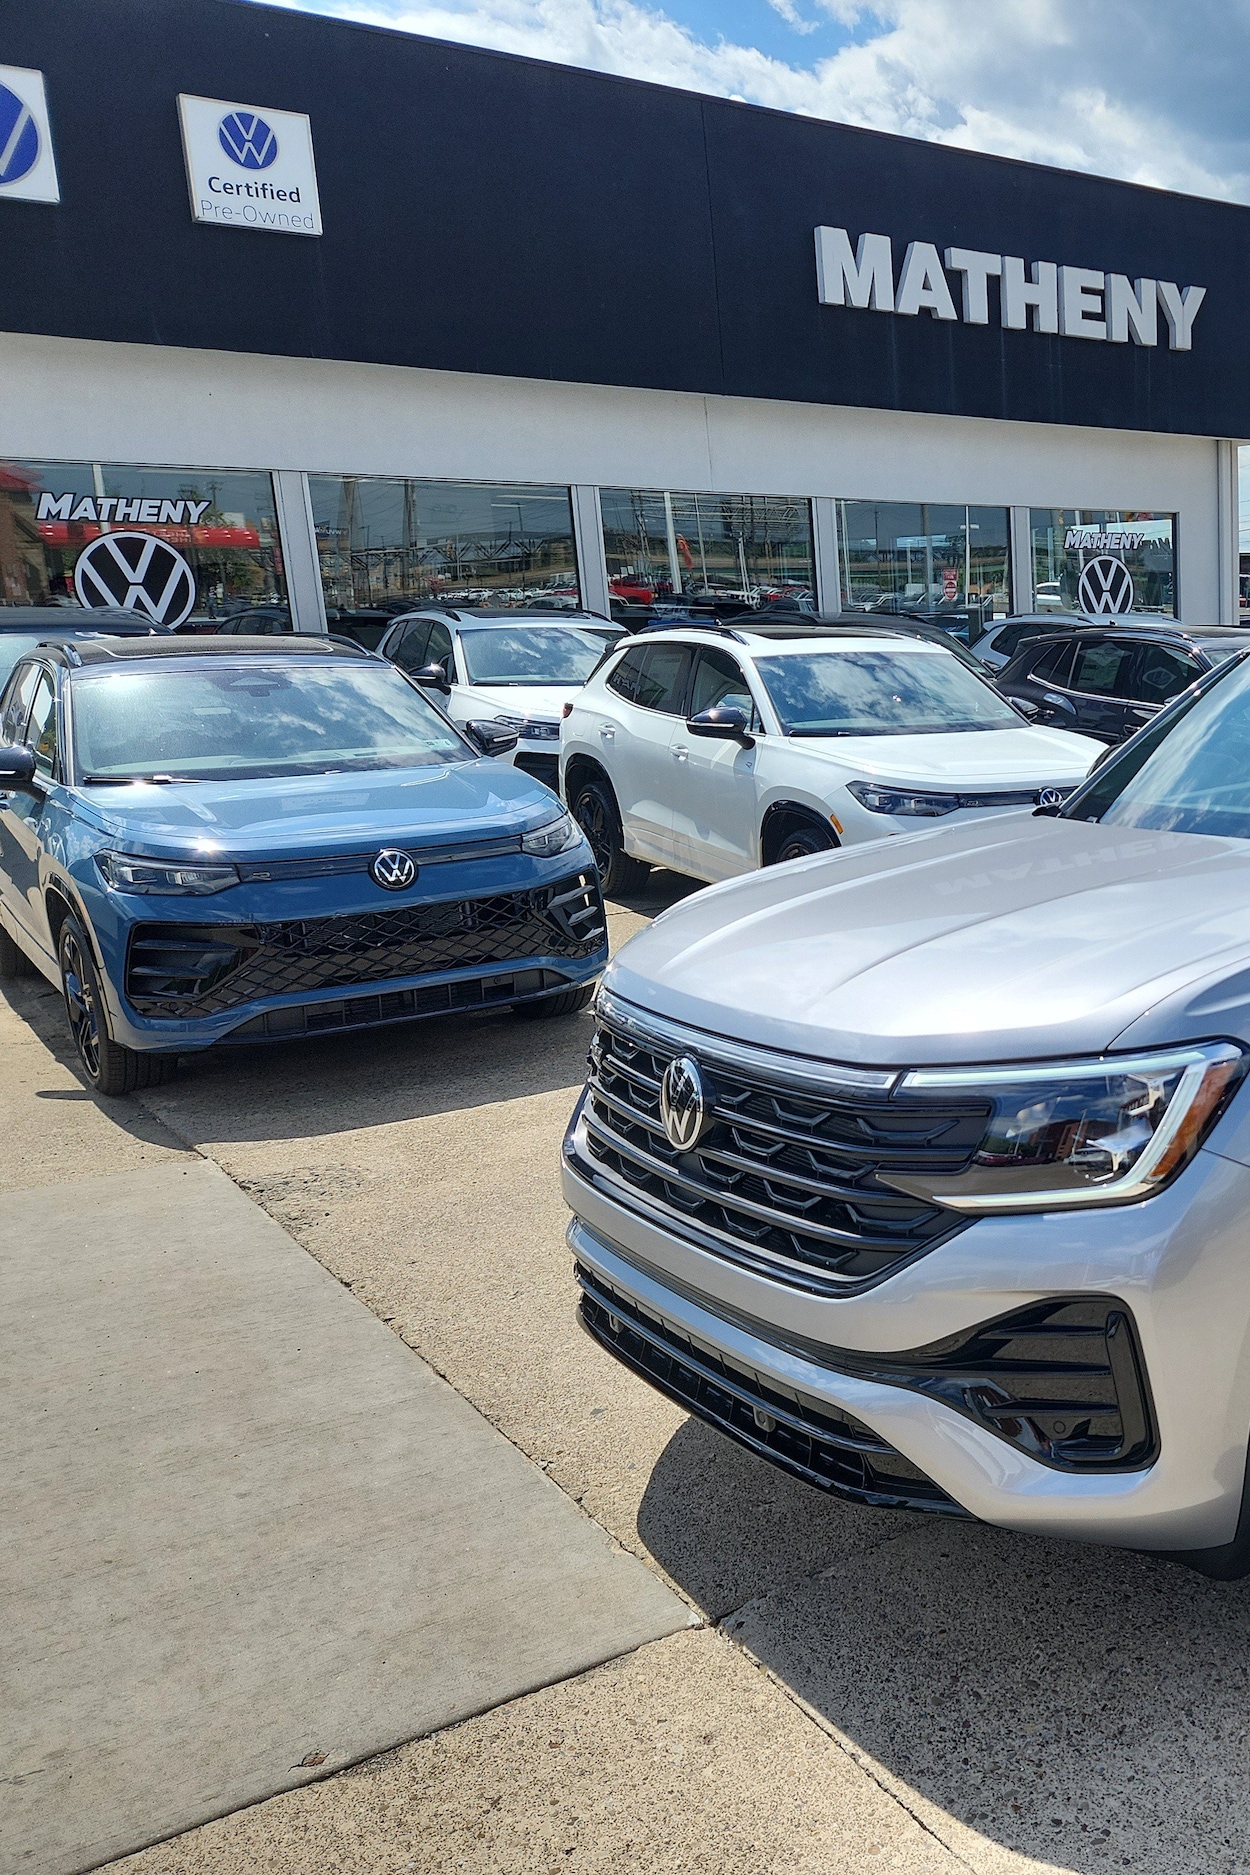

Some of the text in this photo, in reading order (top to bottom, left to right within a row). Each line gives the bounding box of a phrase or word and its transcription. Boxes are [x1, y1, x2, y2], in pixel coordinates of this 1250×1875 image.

[208, 176, 301, 203] Certified
[200, 200, 314, 229] Pre-Owned
[814, 225, 1207, 352] MATHENY
[36, 492, 211, 524] MATHENY
[1064, 530, 1144, 549] MATHENY
